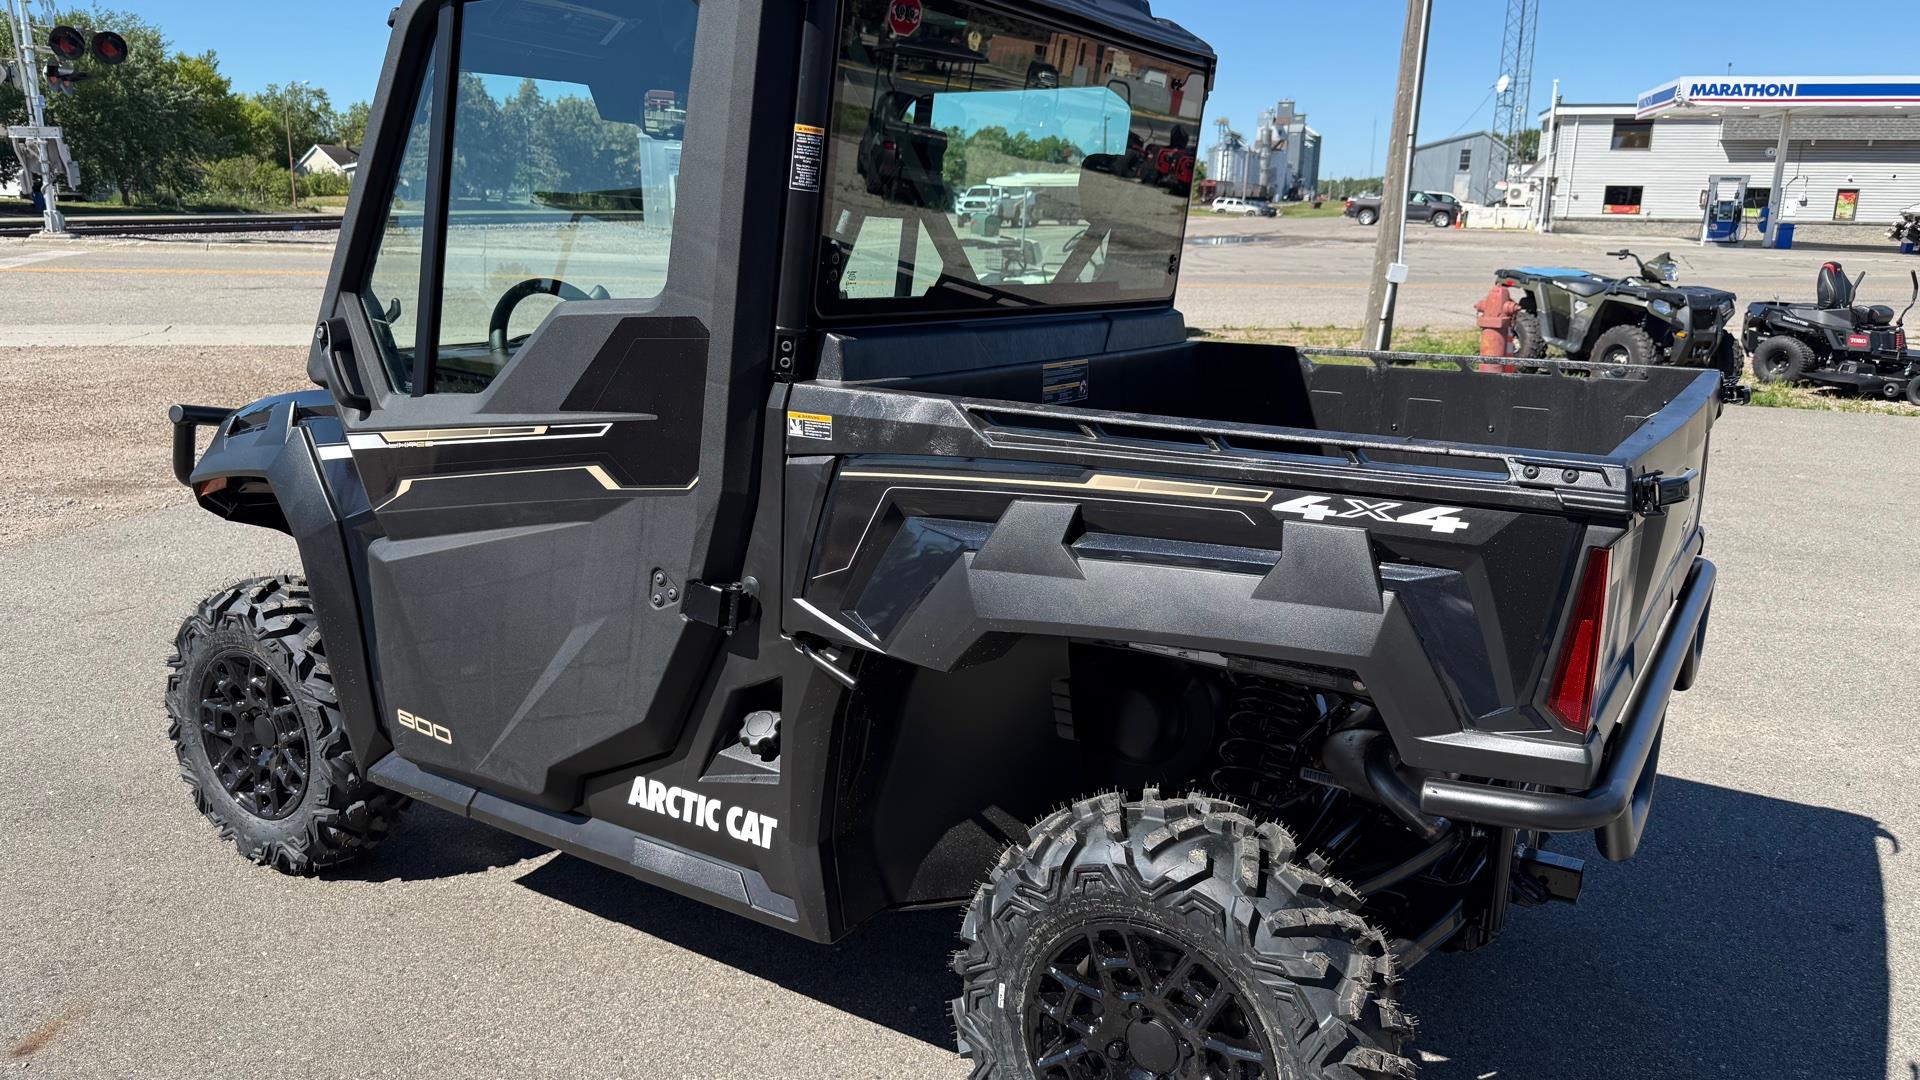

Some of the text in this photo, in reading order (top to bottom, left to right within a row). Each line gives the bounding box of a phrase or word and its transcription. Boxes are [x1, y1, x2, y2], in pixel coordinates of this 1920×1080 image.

[1689, 83, 1794, 97] MARATHON
[397, 708, 453, 745] 800
[627, 776, 778, 850] ARCTIC CAT
